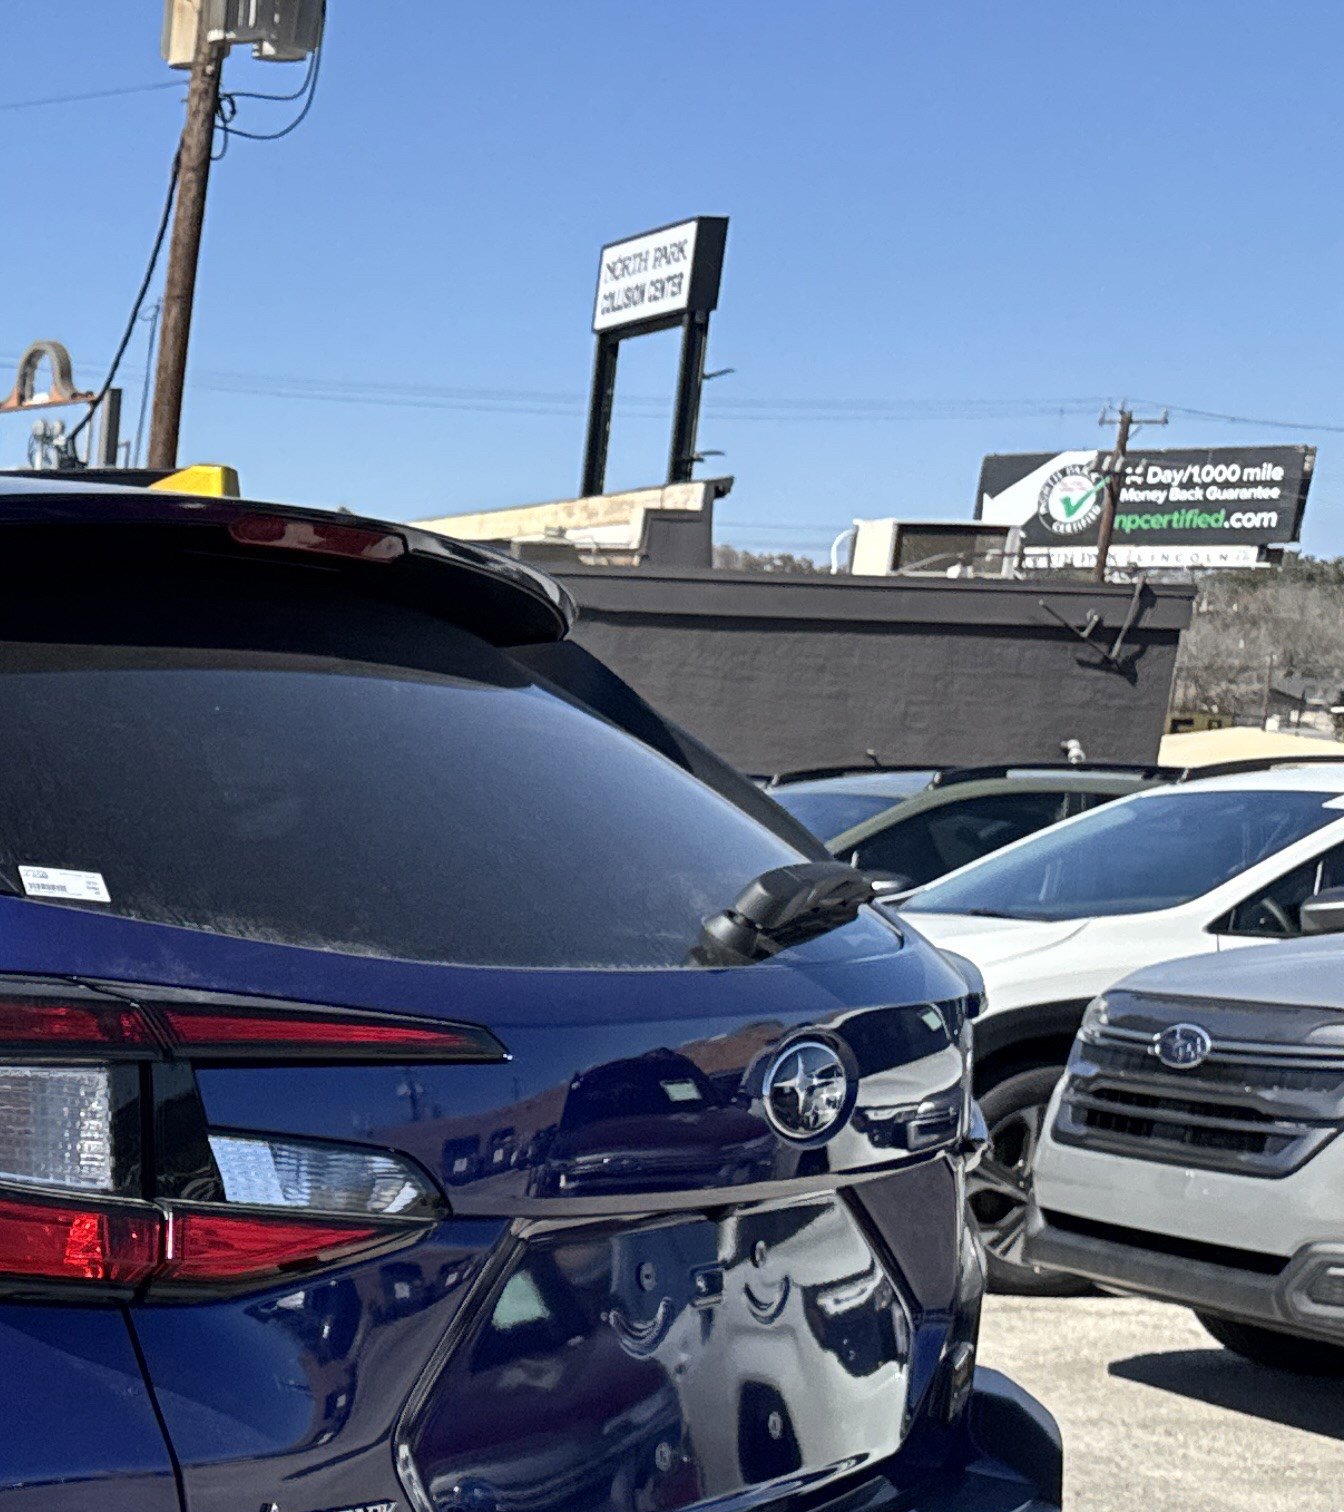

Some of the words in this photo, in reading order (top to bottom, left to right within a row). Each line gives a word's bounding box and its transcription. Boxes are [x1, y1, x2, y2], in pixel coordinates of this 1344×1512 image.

[1242, 462, 1285, 482] mile
[1119, 487, 1167, 504] Money
[1169, 486, 1204, 501] Back
[1205, 485, 1281, 501] Guarantee
[1113, 508, 1278, 534] npcertified.com
